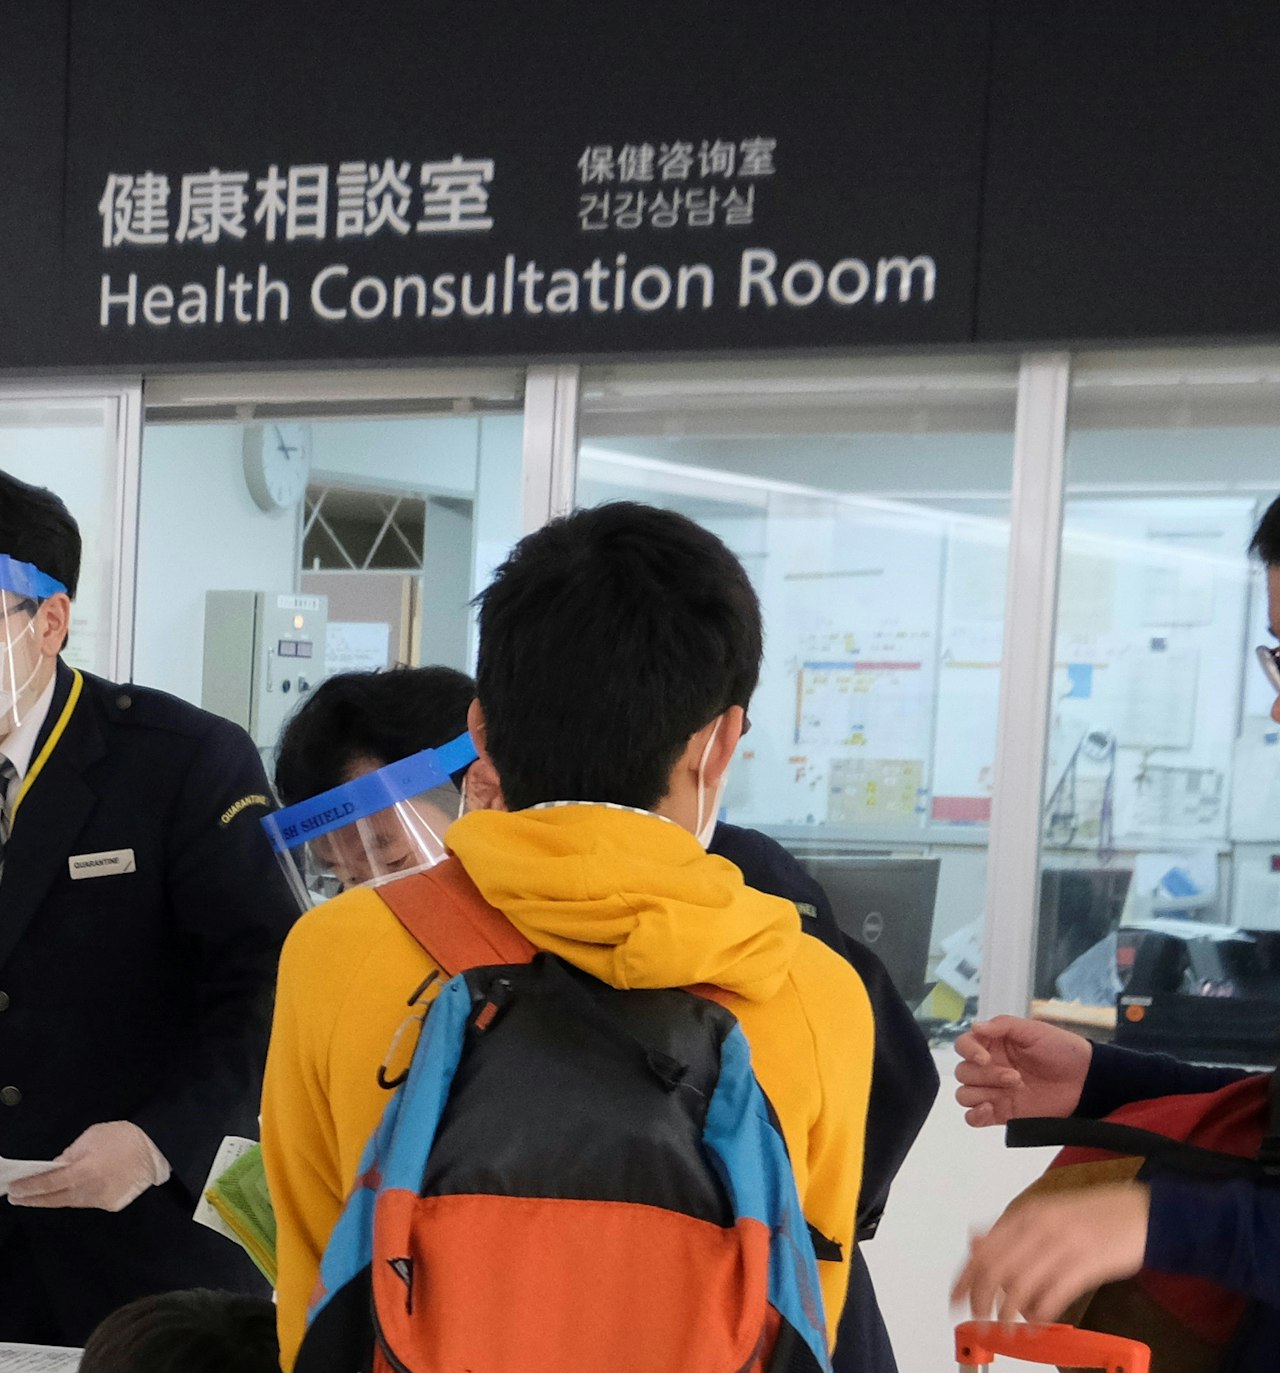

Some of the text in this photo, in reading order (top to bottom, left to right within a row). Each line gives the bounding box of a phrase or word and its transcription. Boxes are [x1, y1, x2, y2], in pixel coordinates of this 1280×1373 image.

[577, 137, 777, 184] 保健咨询室
[97, 156, 496, 248] 健康相談室
[578, 185, 755, 231] 건강상담실
[99, 248, 937, 328] Health Consultation Room
[220, 793, 268, 824] QUARANTINE
[301, 801, 355, 834] SHIELD
[73, 856, 120, 869] QUARANTINE
